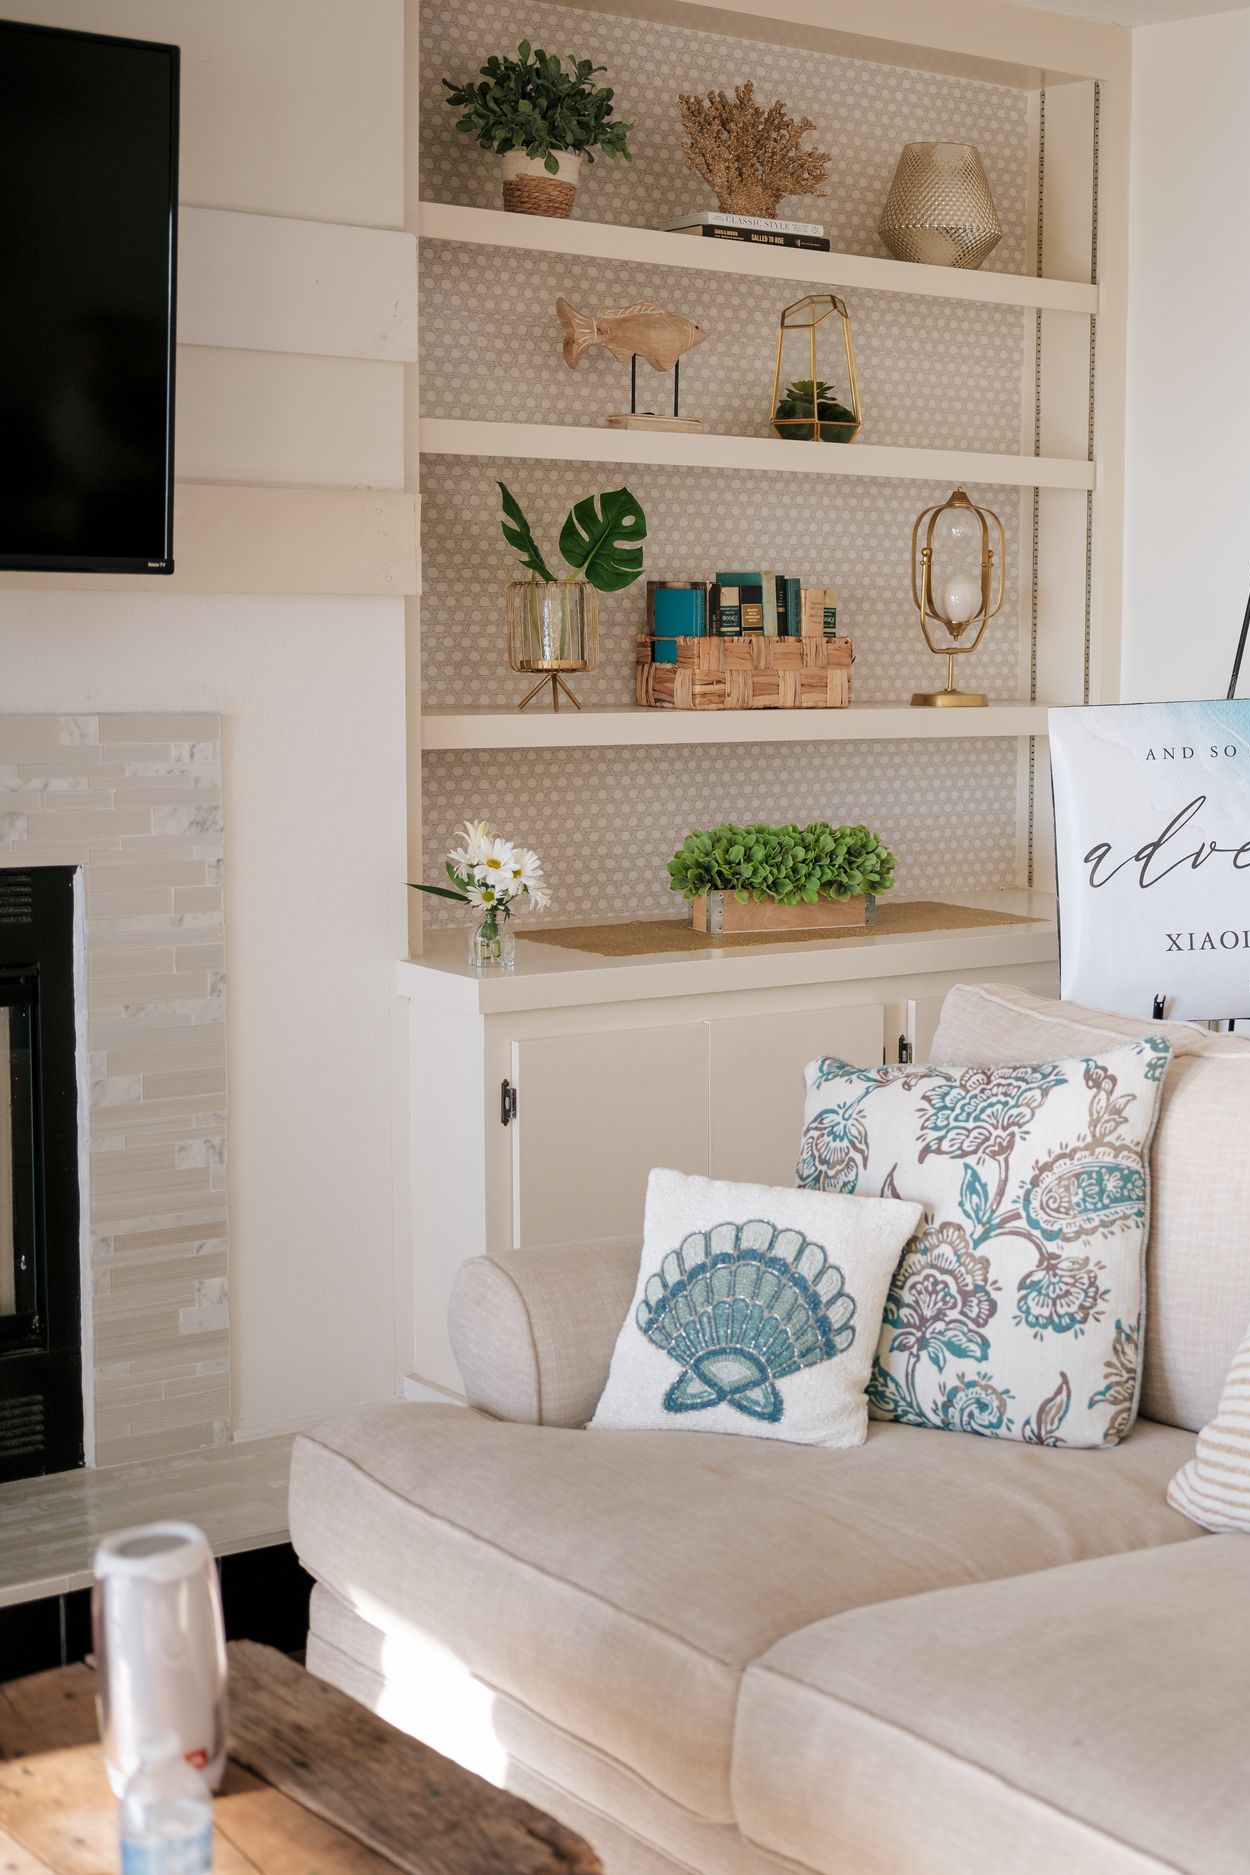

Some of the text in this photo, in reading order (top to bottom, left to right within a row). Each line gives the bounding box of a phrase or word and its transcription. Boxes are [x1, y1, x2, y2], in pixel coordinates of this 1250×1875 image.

[725, 215, 763, 228] CLASSIC
[765, 219, 790, 231] STYLE
[751, 234, 768, 244] CALLED
[768, 236, 774, 244] TO
[774, 236, 785, 245] RISE
[1145, 746, 1196, 761] AND
[1209, 744, 1238, 758] SO
